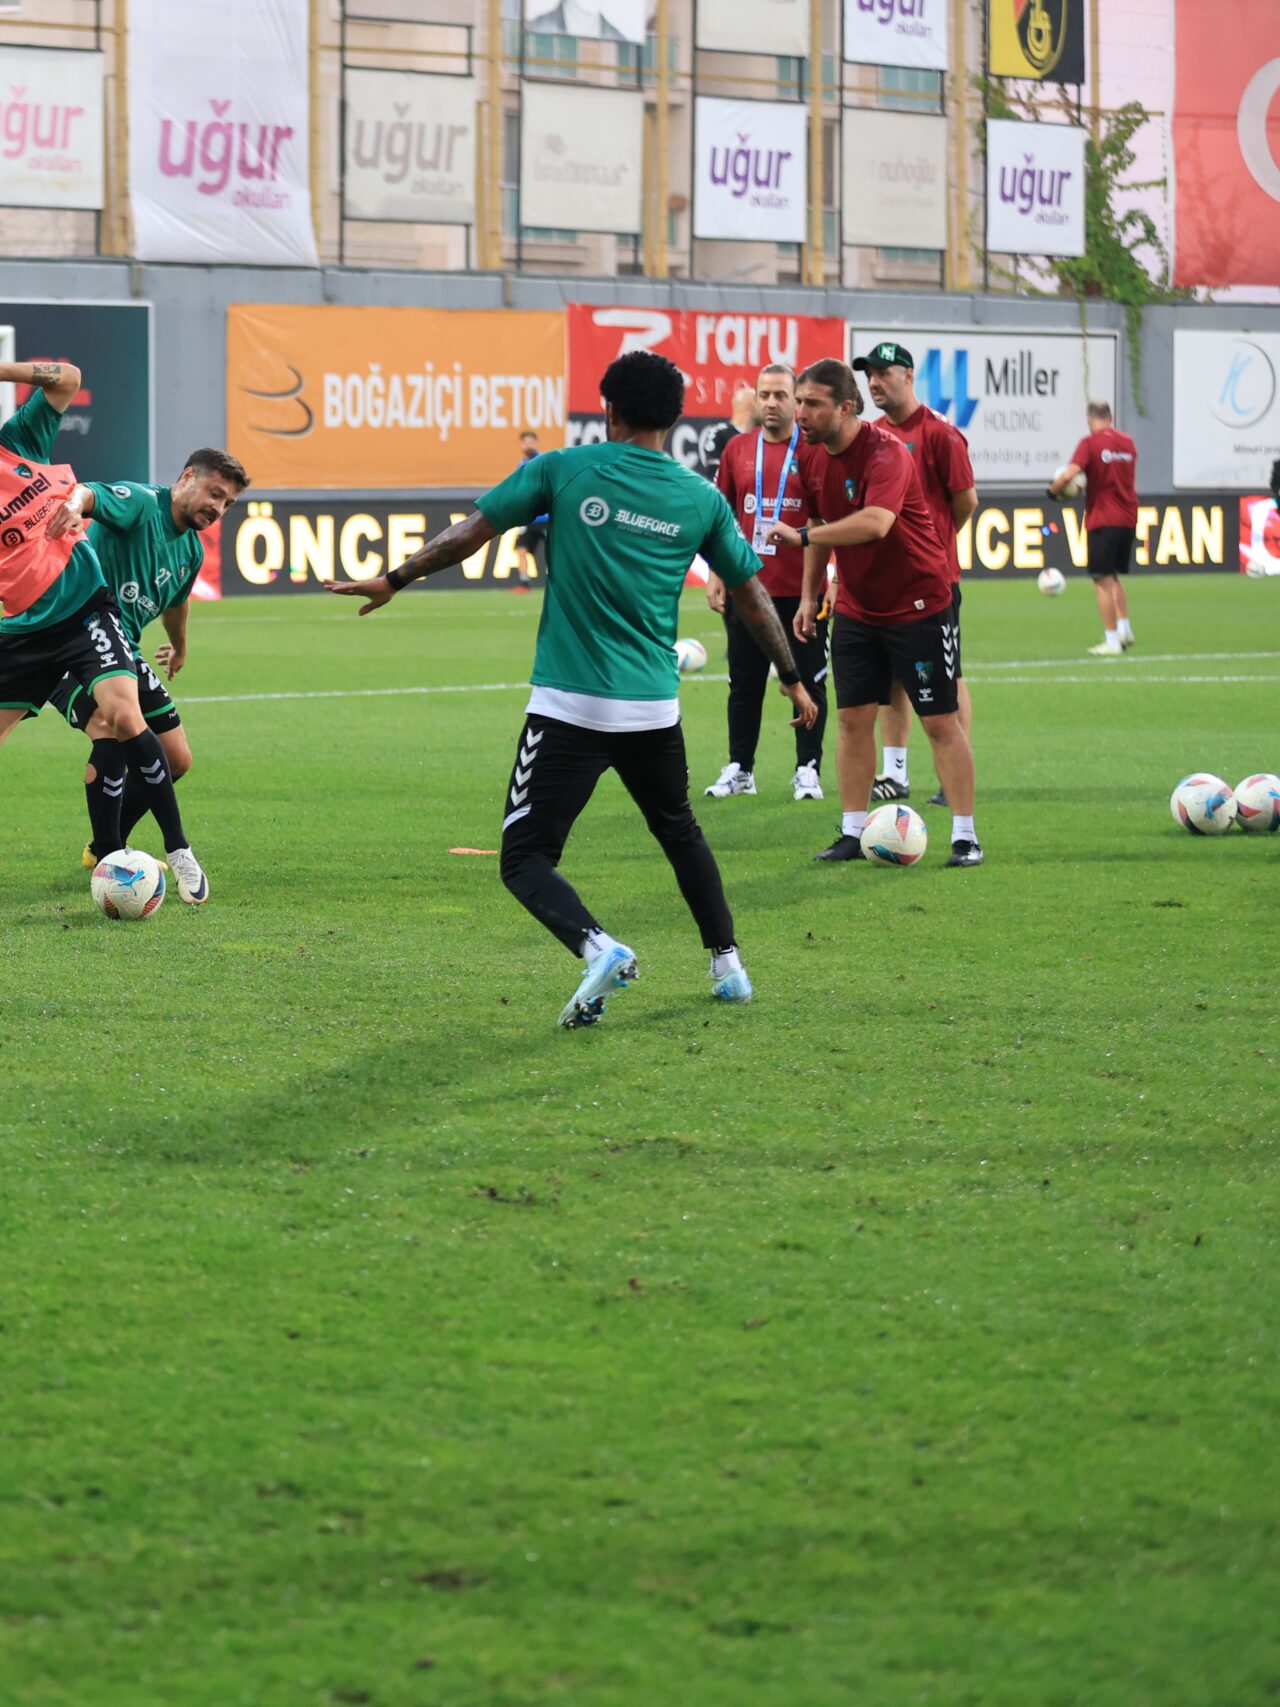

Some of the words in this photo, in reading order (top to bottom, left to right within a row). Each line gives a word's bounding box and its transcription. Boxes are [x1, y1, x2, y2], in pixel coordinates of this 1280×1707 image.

[158, 99, 296, 196] uğur
[352, 102, 469, 184] uğur
[709, 131, 792, 198] uğur
[1000, 154, 1072, 214] uğur
[695, 314, 799, 368] raru
[324, 361, 462, 441] BOĞAZİÇİ
[470, 374, 564, 428] BETON
[985, 350, 1059, 396] Miller
[234, 500, 428, 586] ÖNCE
[613, 508, 682, 537] BLUEFORCE
[956, 507, 1045, 571] NCE
[1061, 505, 1224, 568] VTAN
[154, 567, 173, 588] 27
[90, 627, 112, 653] 3
